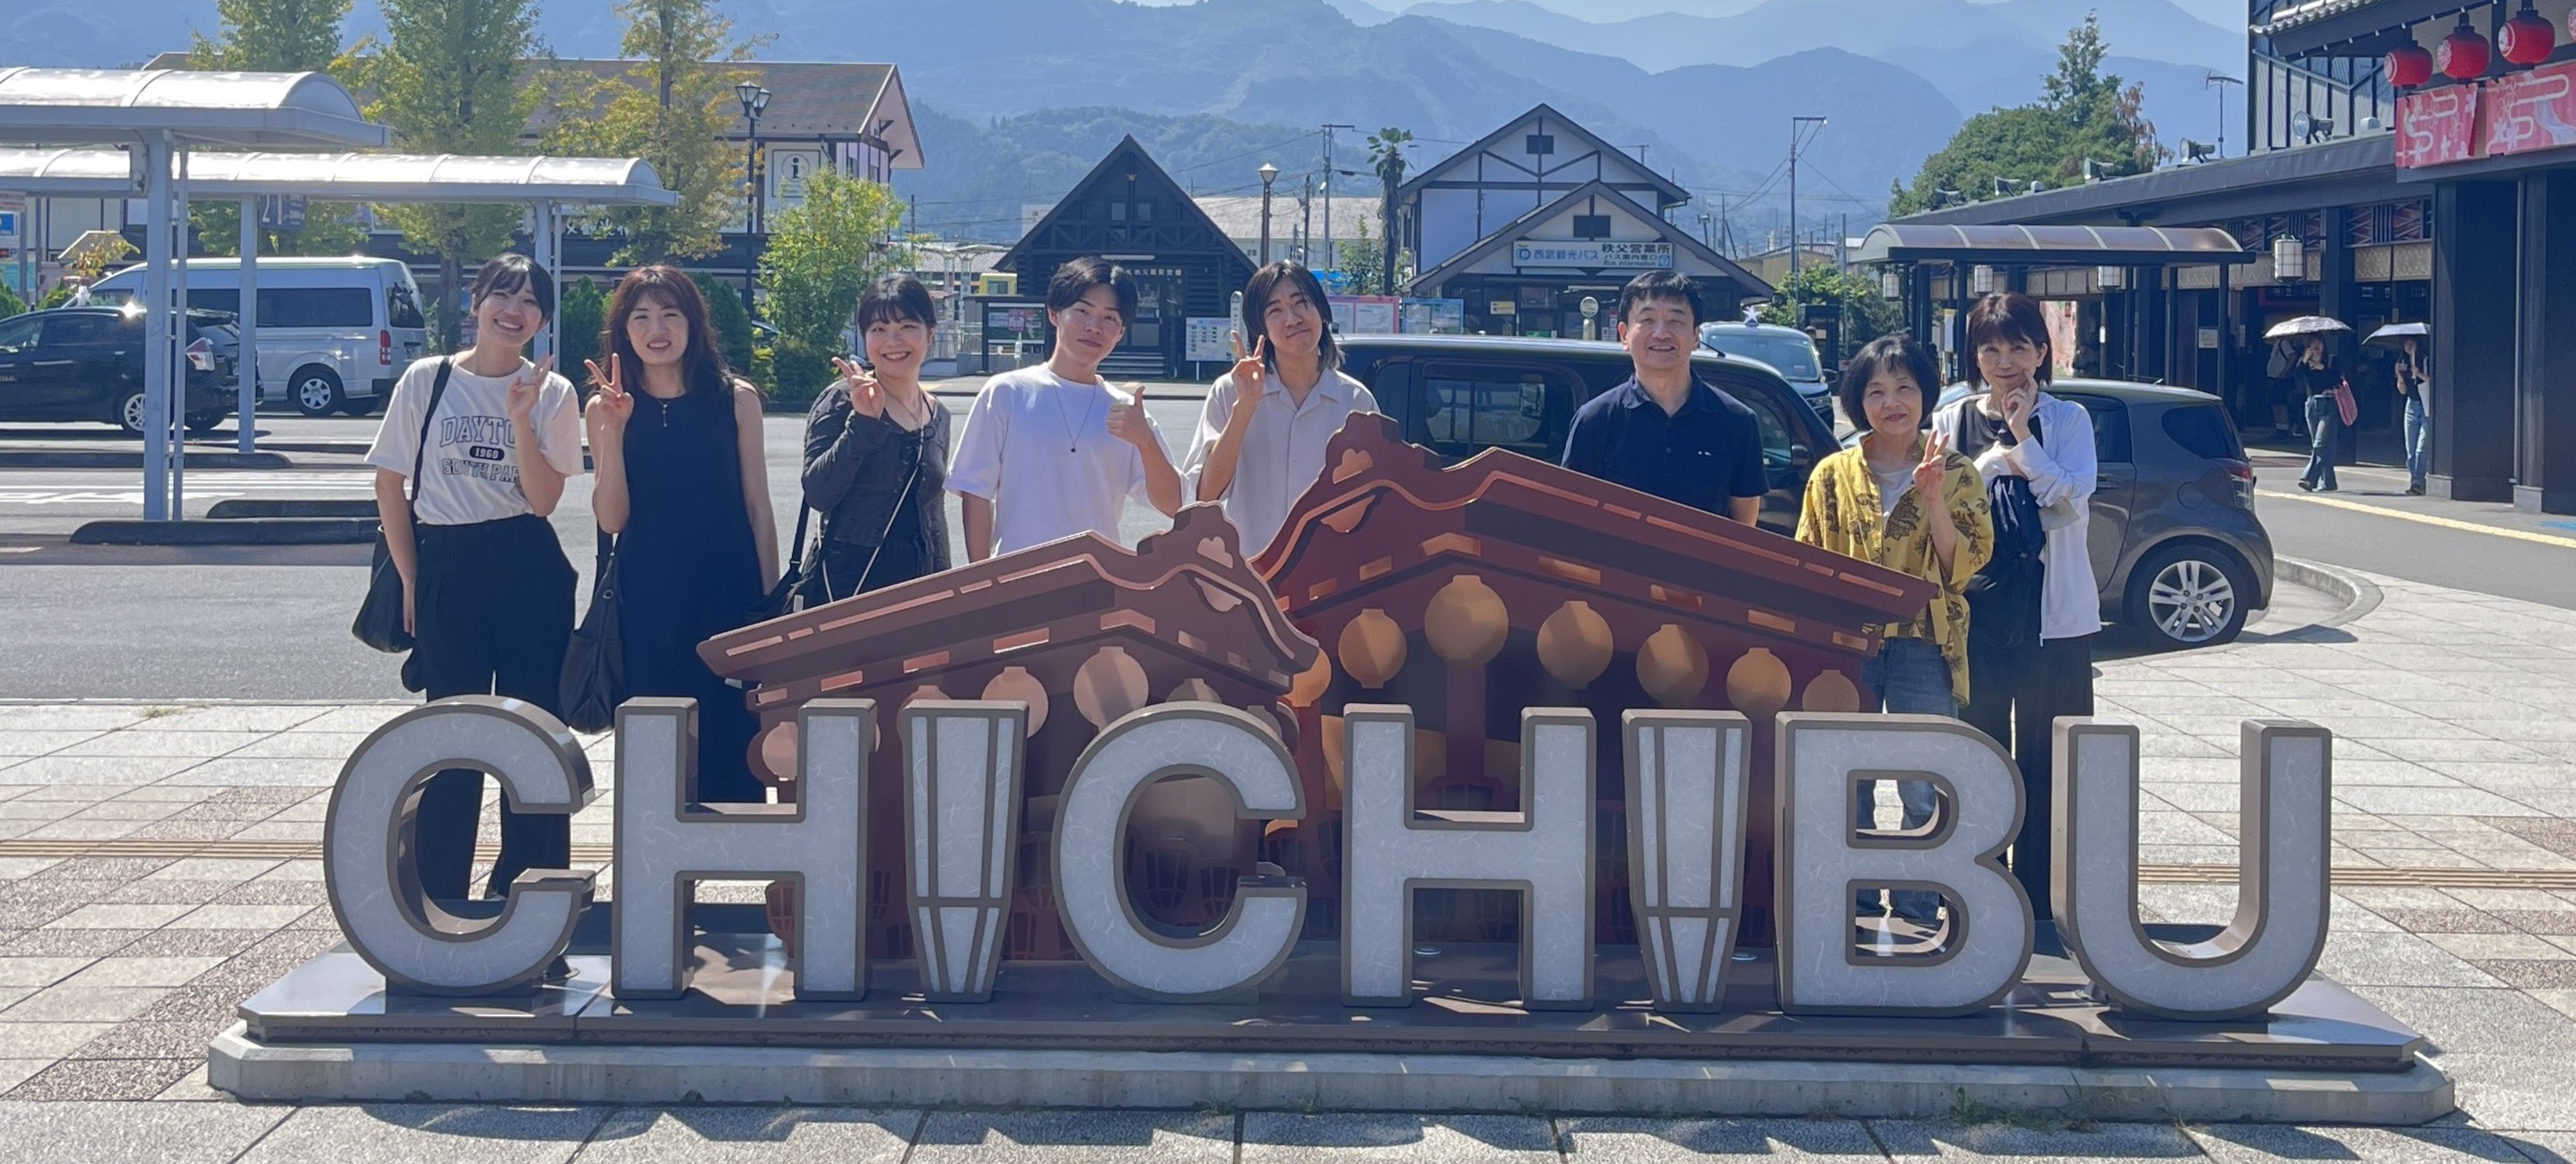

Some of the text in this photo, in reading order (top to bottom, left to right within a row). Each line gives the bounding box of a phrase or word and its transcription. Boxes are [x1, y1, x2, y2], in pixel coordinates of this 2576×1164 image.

[1534, 248, 1599, 261] 西武観光バス
[1602, 243, 1671, 255] 秩父営業所
[439, 415, 516, 448] DAYTO
[474, 447, 500, 459] 1960
[442, 457, 520, 483] SOUTH PAR
[324, 695, 2332, 1022] CHICHIBU
